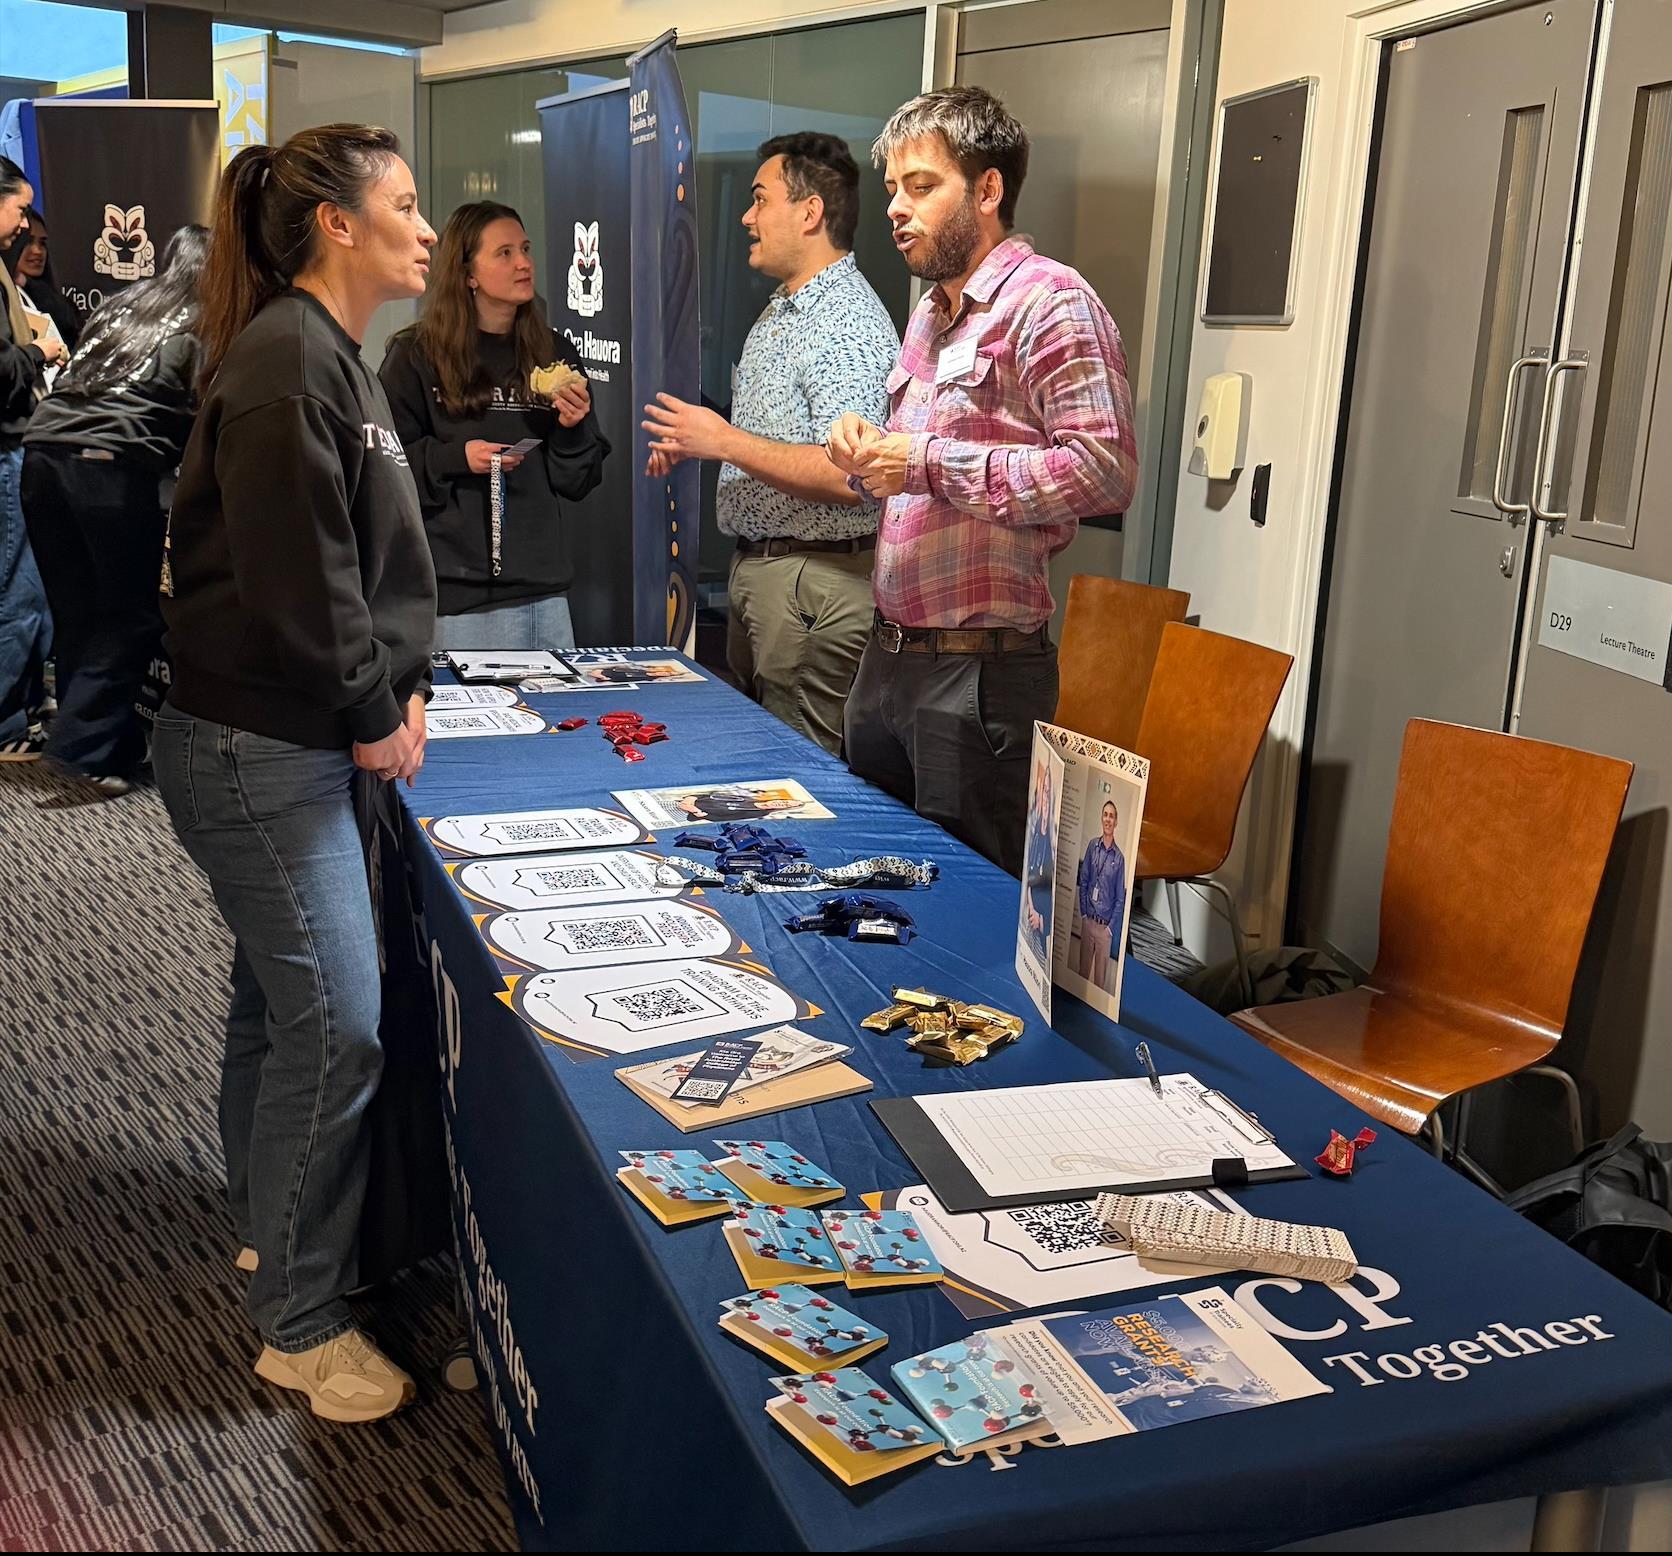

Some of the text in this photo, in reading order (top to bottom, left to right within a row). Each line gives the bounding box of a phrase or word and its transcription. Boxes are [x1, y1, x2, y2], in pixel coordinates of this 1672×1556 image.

[583, 330, 621, 365] Hauora
[1550, 612, 1572, 632] D29
[1600, 633, 1656, 660] Lecture Theatre
[680, 968, 717, 993] TRAINING
[714, 991, 763, 1020] PATHWAYS
[700, 970, 735, 996] DIAGRAM
[747, 999, 769, 1013] THE
[461, 1164, 538, 1437] Together
[788, 1312, 824, 1338] Foundation
[1219, 1307, 1244, 1330] Specialty
[1232, 1266, 1412, 1341] CP
[1079, 1320, 1119, 1351] NOW
[1108, 1315, 1170, 1365] GRANTS
[1125, 1312, 1201, 1376] RESEARCH
[1323, 1315, 1615, 1387] Together
[1007, 1334, 1031, 1354] research
[1024, 1353, 1044, 1369] grants
[1042, 1375, 1060, 1388] value
[1016, 1332, 1045, 1357] candidates
[1044, 1365, 1068, 1383] eligible
[1064, 1388, 1083, 1403] apply
[1027, 1330, 1115, 1424] Did you know that you and your research
[820, 1385, 873, 1432] RACP Foundation
[957, 1362, 1002, 1411] RACP Foundation
